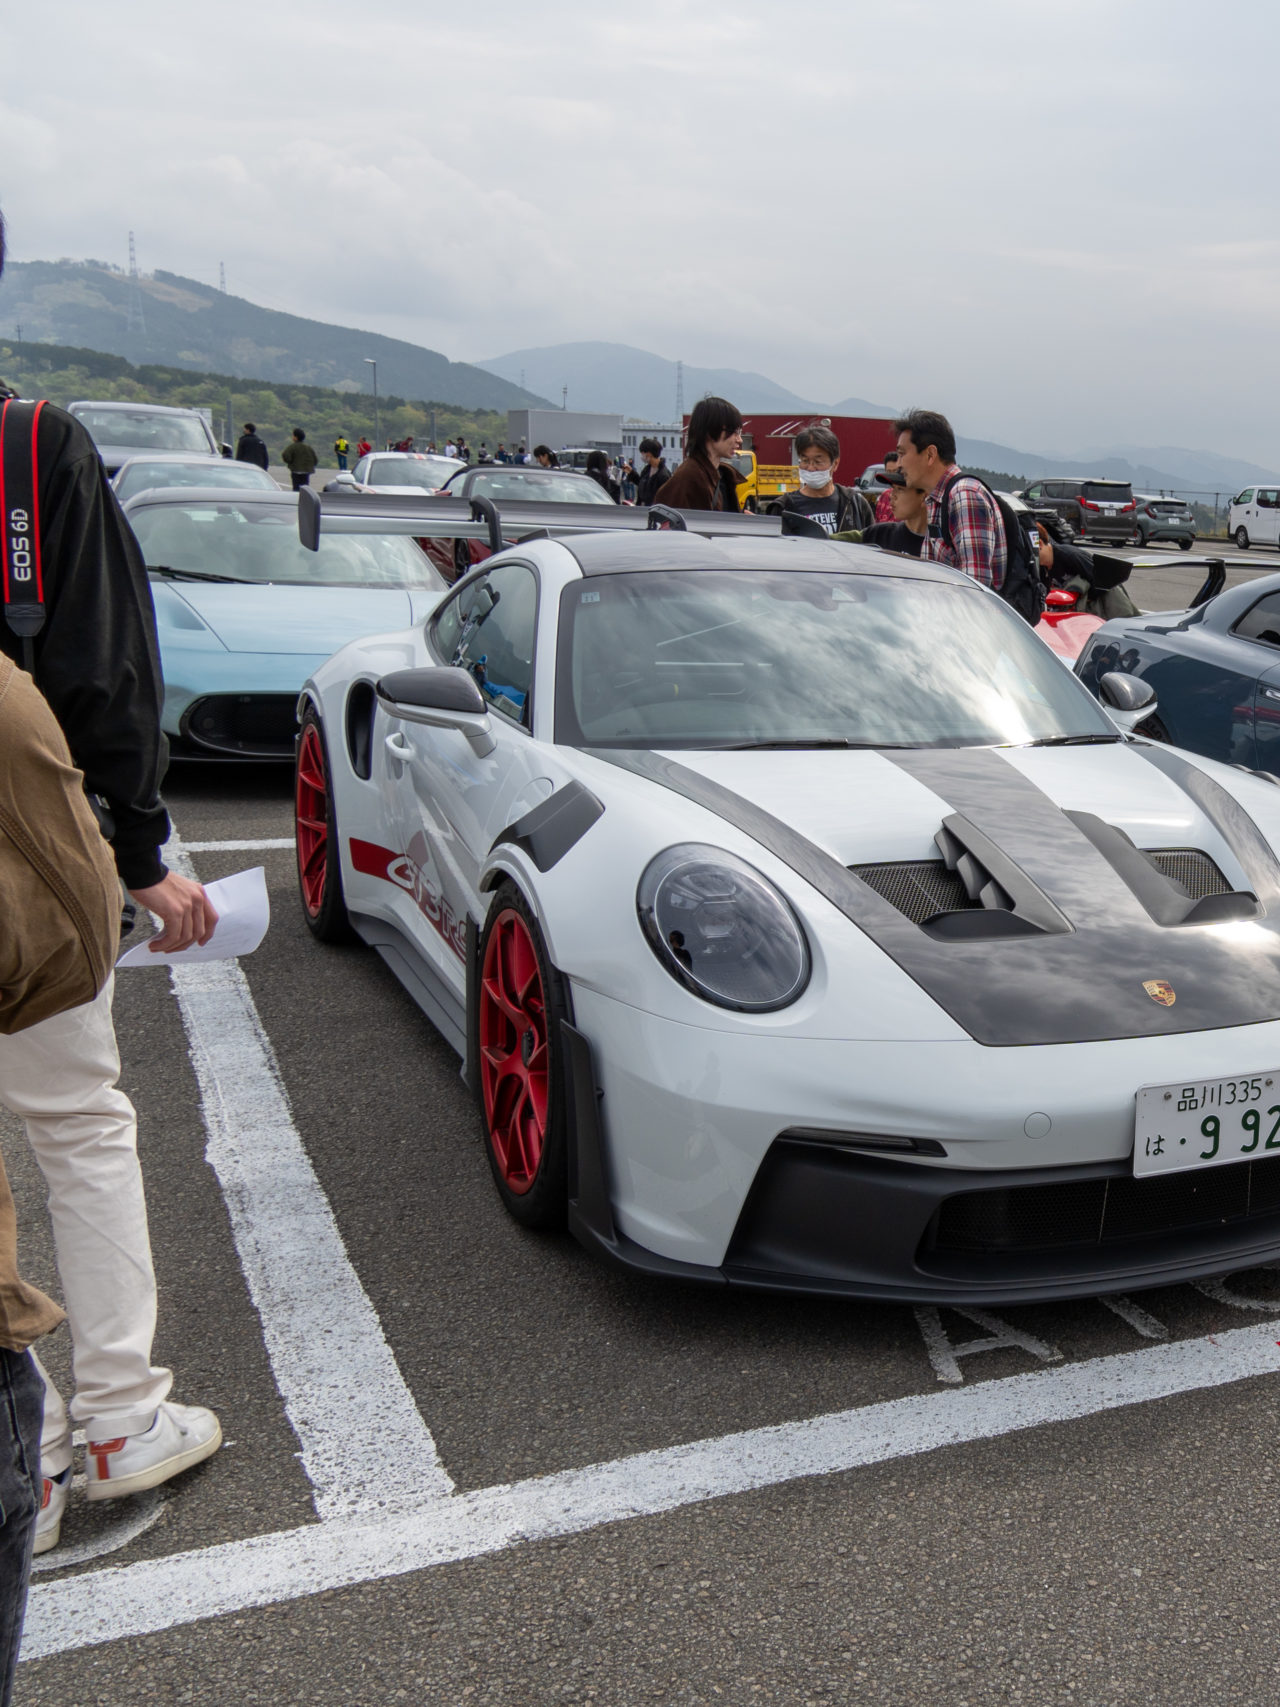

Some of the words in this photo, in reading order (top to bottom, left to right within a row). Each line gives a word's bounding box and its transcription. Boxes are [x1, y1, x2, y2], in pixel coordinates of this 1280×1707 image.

[11, 508, 29, 532] 6D
[12, 536, 32, 581] EOS
[1146, 1135, 1165, 1157] は
